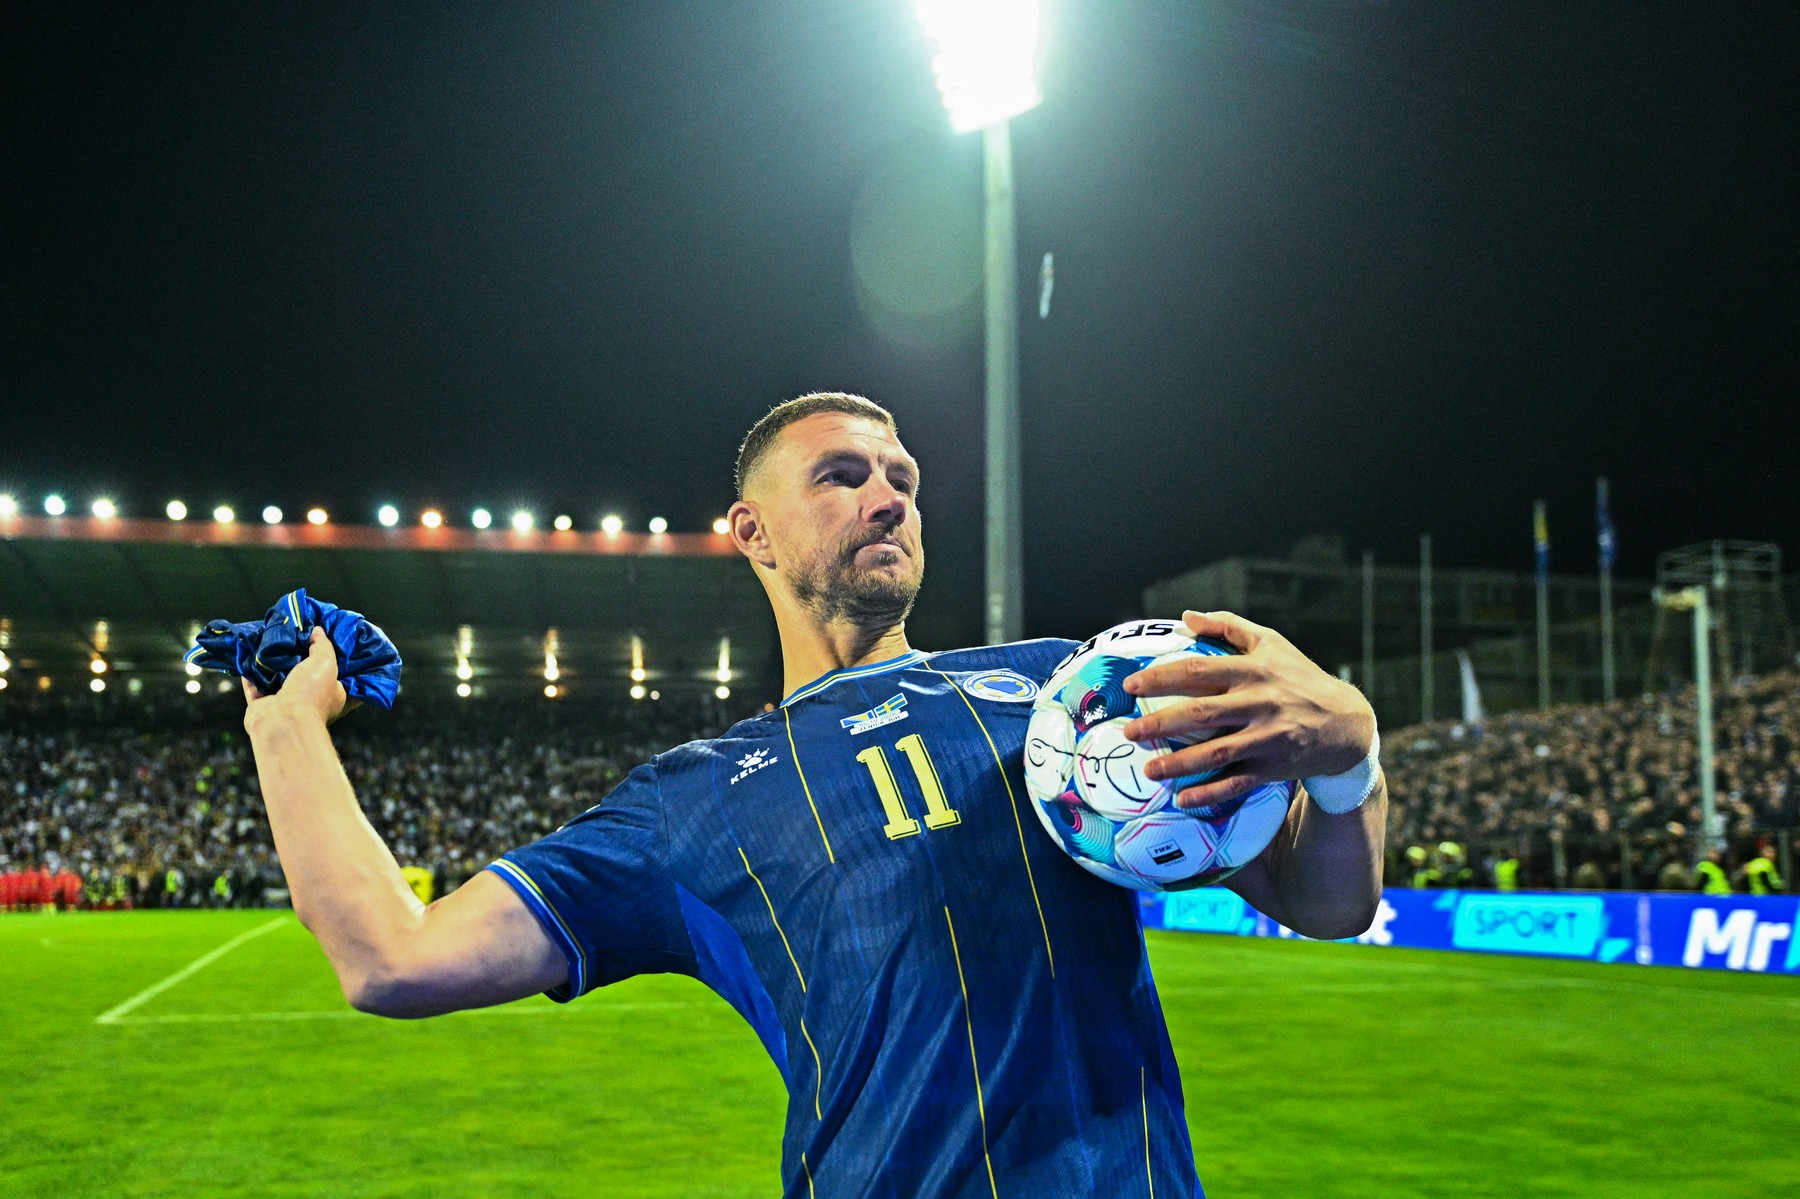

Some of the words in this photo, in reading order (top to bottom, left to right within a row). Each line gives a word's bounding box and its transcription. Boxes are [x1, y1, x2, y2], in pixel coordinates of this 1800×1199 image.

[730, 756, 778, 785] KELME
[855, 733, 961, 840] 11
[1474, 908, 1579, 939] SPORT
